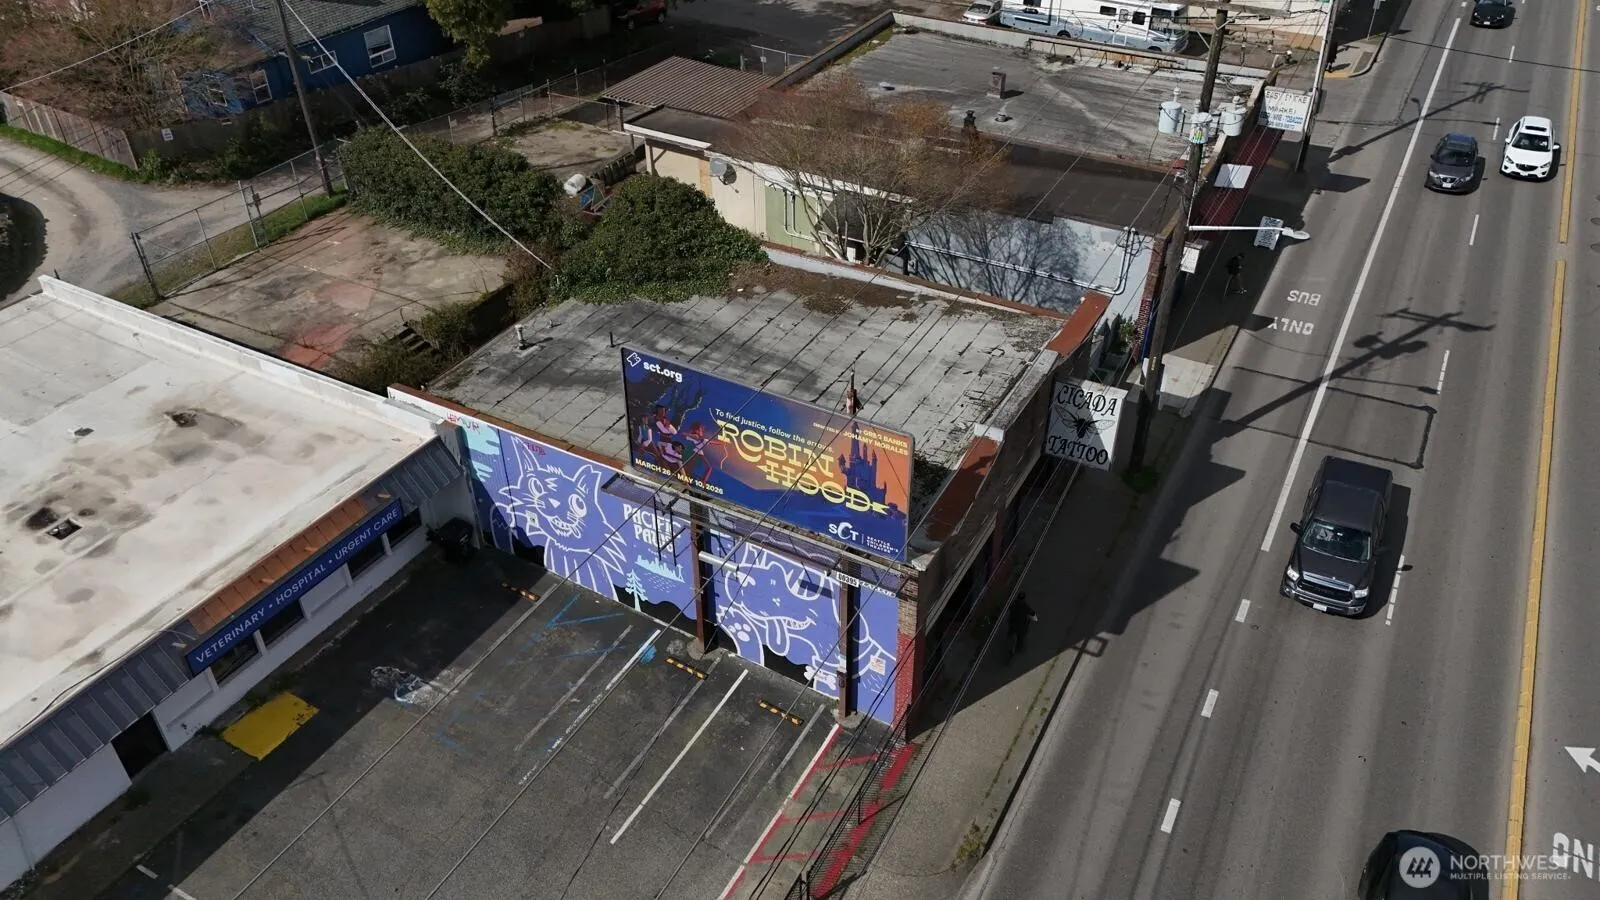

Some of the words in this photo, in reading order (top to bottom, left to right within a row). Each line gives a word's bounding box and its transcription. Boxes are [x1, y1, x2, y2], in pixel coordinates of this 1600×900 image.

[1287, 289, 1321, 306] BUS
[1267, 316, 1314, 335] ONLY
[643, 361, 683, 383] sct.org
[1057, 385, 1117, 416] CICADA
[715, 408, 724, 417] To
[726, 411, 740, 422] find
[741, 415, 767, 432] justice,
[769, 426, 791, 439] follow
[793, 434, 805, 443] the
[717, 420, 834, 477] ROBIN
[874, 440, 908, 455] MORALES
[1048, 435, 1108, 464] TATTOO
[635, 458, 661, 473] MARCH
[677, 473, 693, 484] MAY
[764, 459, 873, 513] HOOD
[196, 608, 265, 663] VETERINARY
[275, 565, 326, 606] HOSPITAL
[334, 529, 371, 560] URGENT
[373, 508, 398, 531] CARE
